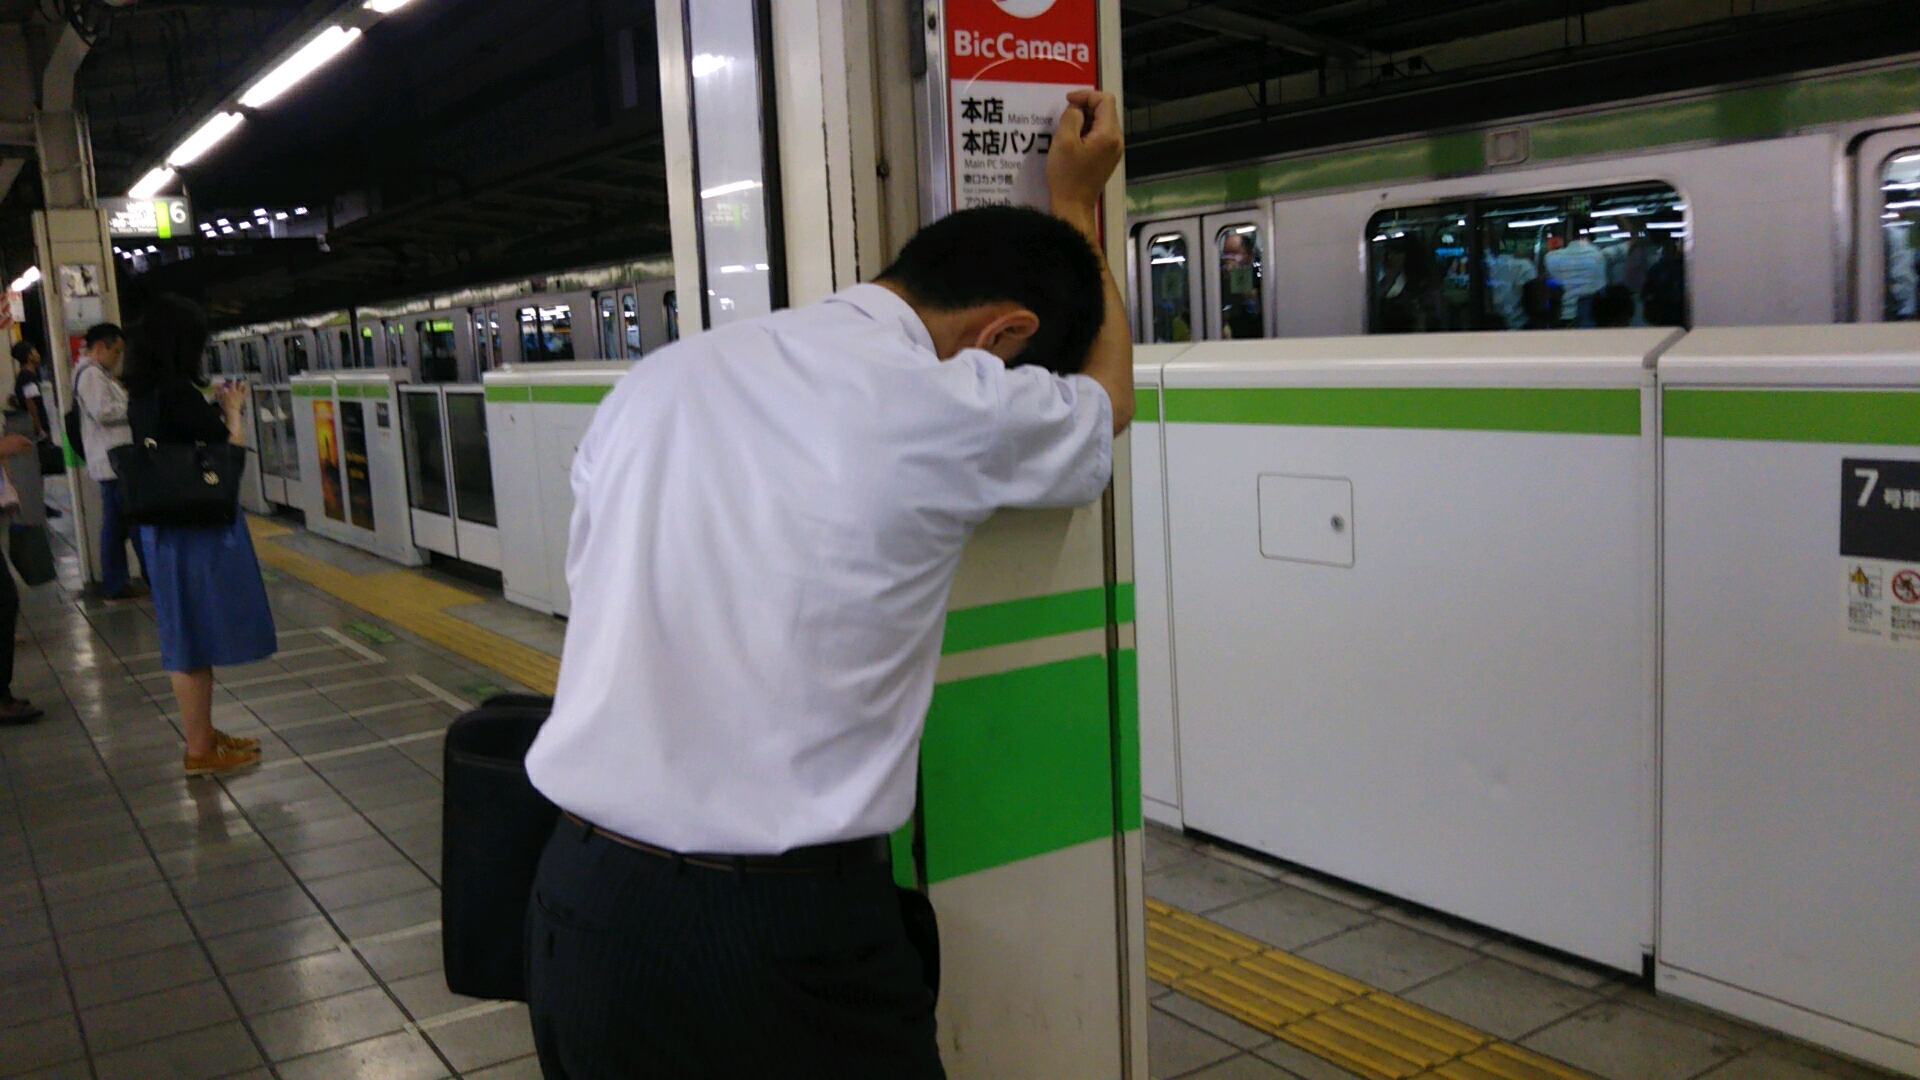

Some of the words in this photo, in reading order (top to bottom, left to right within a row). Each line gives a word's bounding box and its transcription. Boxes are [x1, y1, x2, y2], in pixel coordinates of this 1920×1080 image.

[954, 30, 1090, 63] BicCamera
[961, 97, 1004, 124] 本店
[1008, 113, 1030, 125] Main
[964, 159, 985, 170] Main
[169, 201, 186, 224] 6
